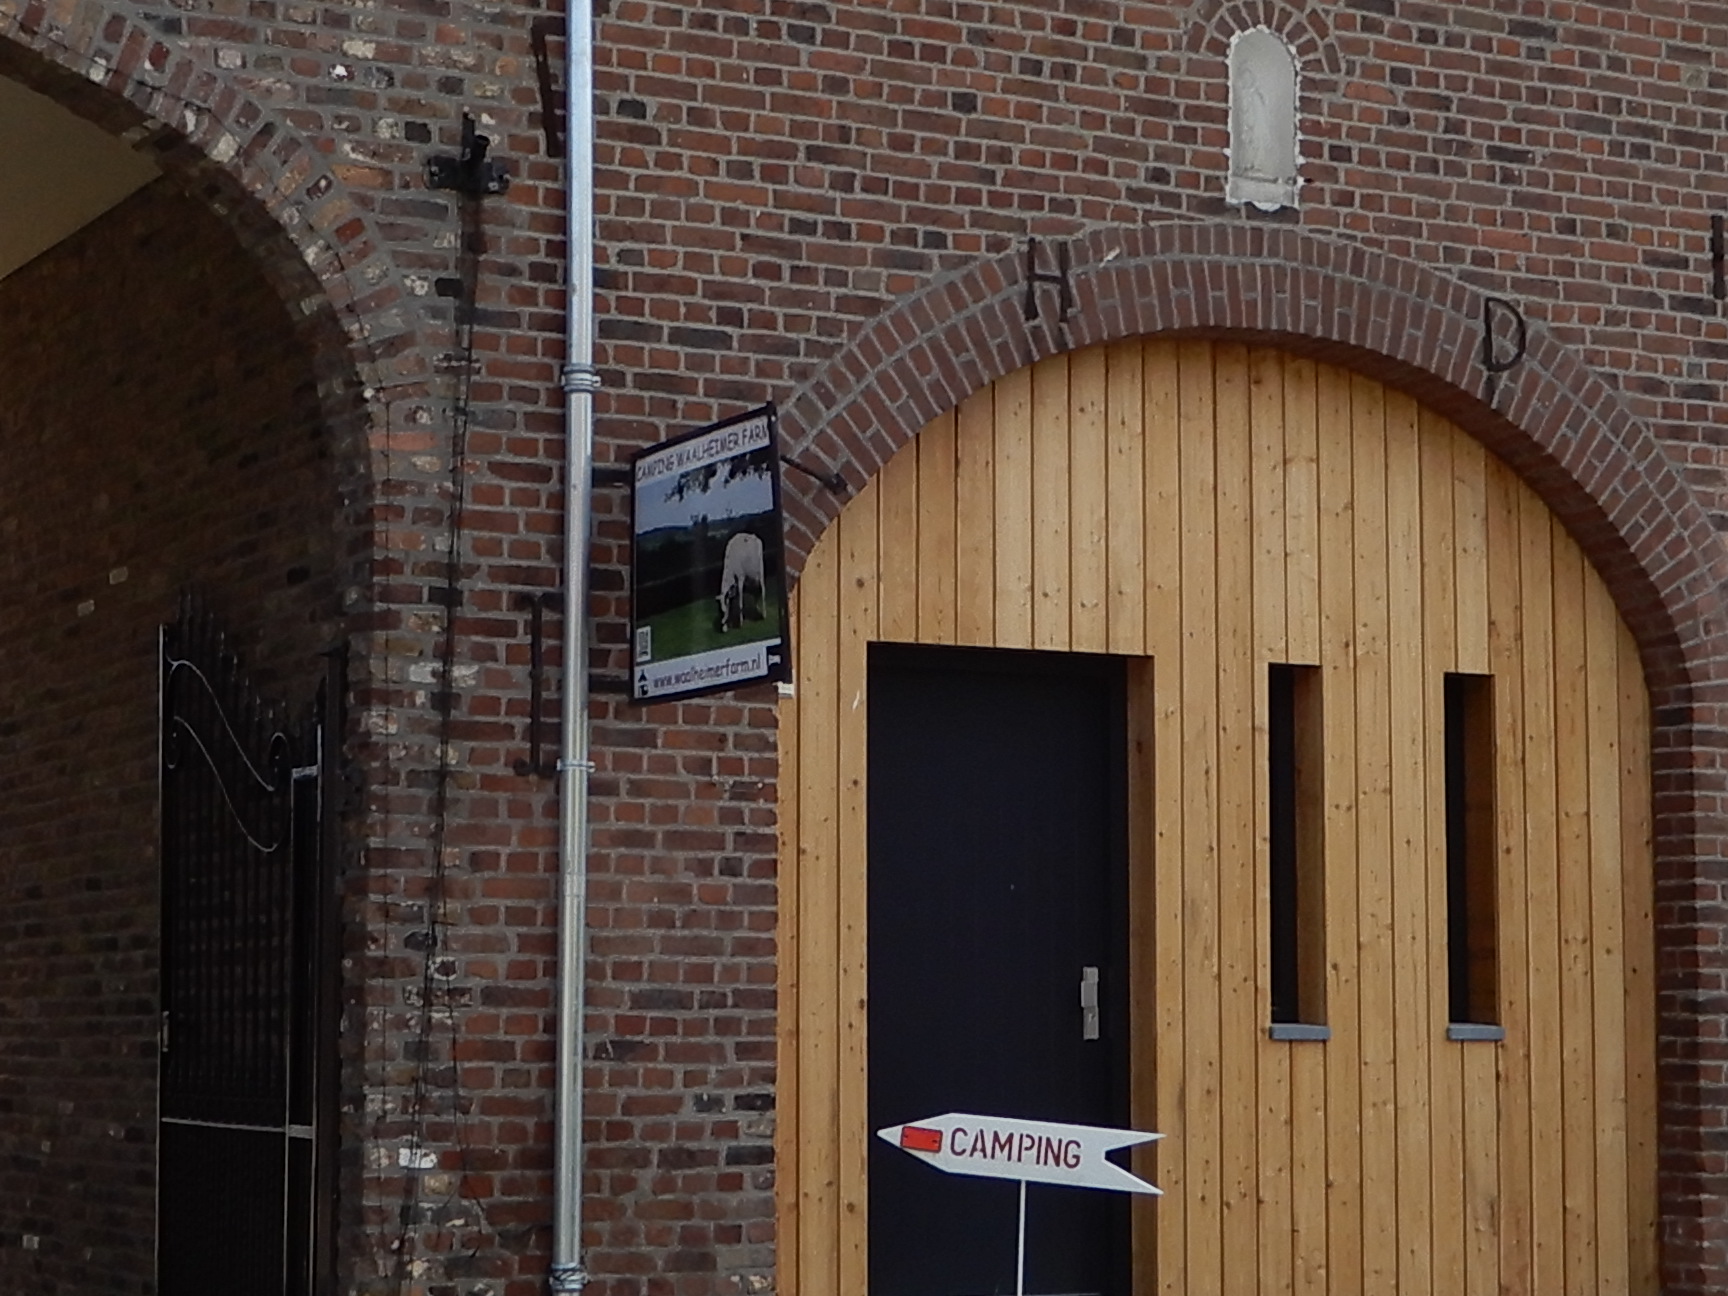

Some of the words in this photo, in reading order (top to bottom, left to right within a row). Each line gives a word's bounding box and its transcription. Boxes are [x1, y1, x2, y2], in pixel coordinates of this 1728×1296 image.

[636, 454, 675, 482] CAMPING
[676, 432, 739, 466] WAALHEIMER
[950, 1127, 1082, 1170] CAMPING
